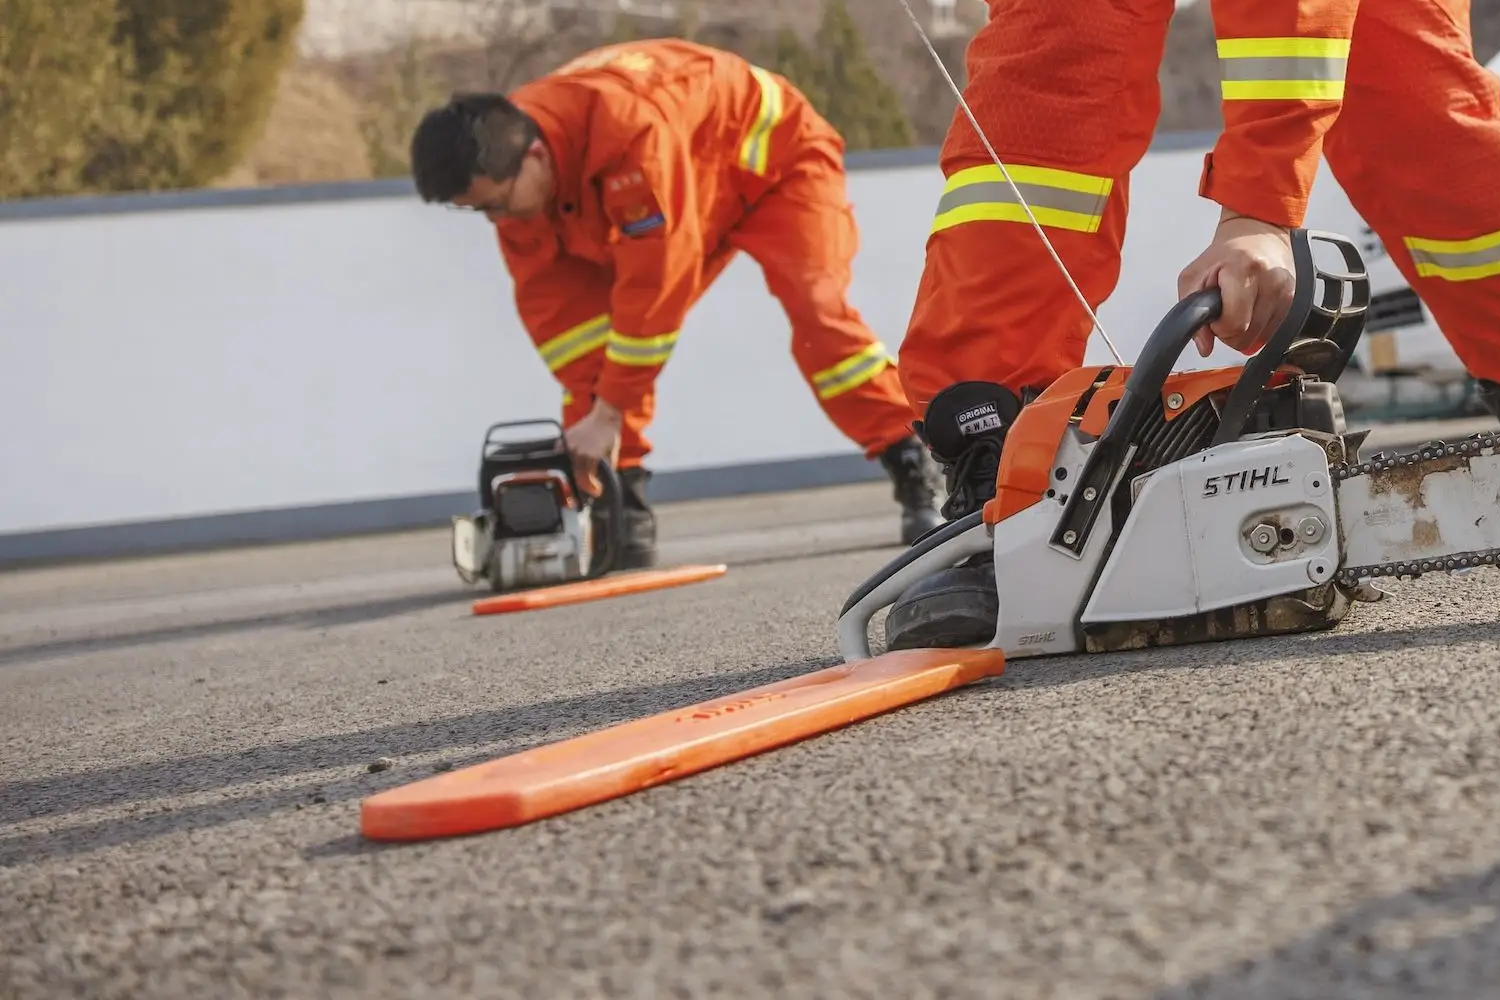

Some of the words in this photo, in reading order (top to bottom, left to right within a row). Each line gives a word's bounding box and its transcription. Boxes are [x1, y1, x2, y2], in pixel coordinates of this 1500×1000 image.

[958, 404, 996, 422] ORIGINAL
[1203, 466, 1290, 499] STIHL
[1018, 631, 1056, 646] STIHL
